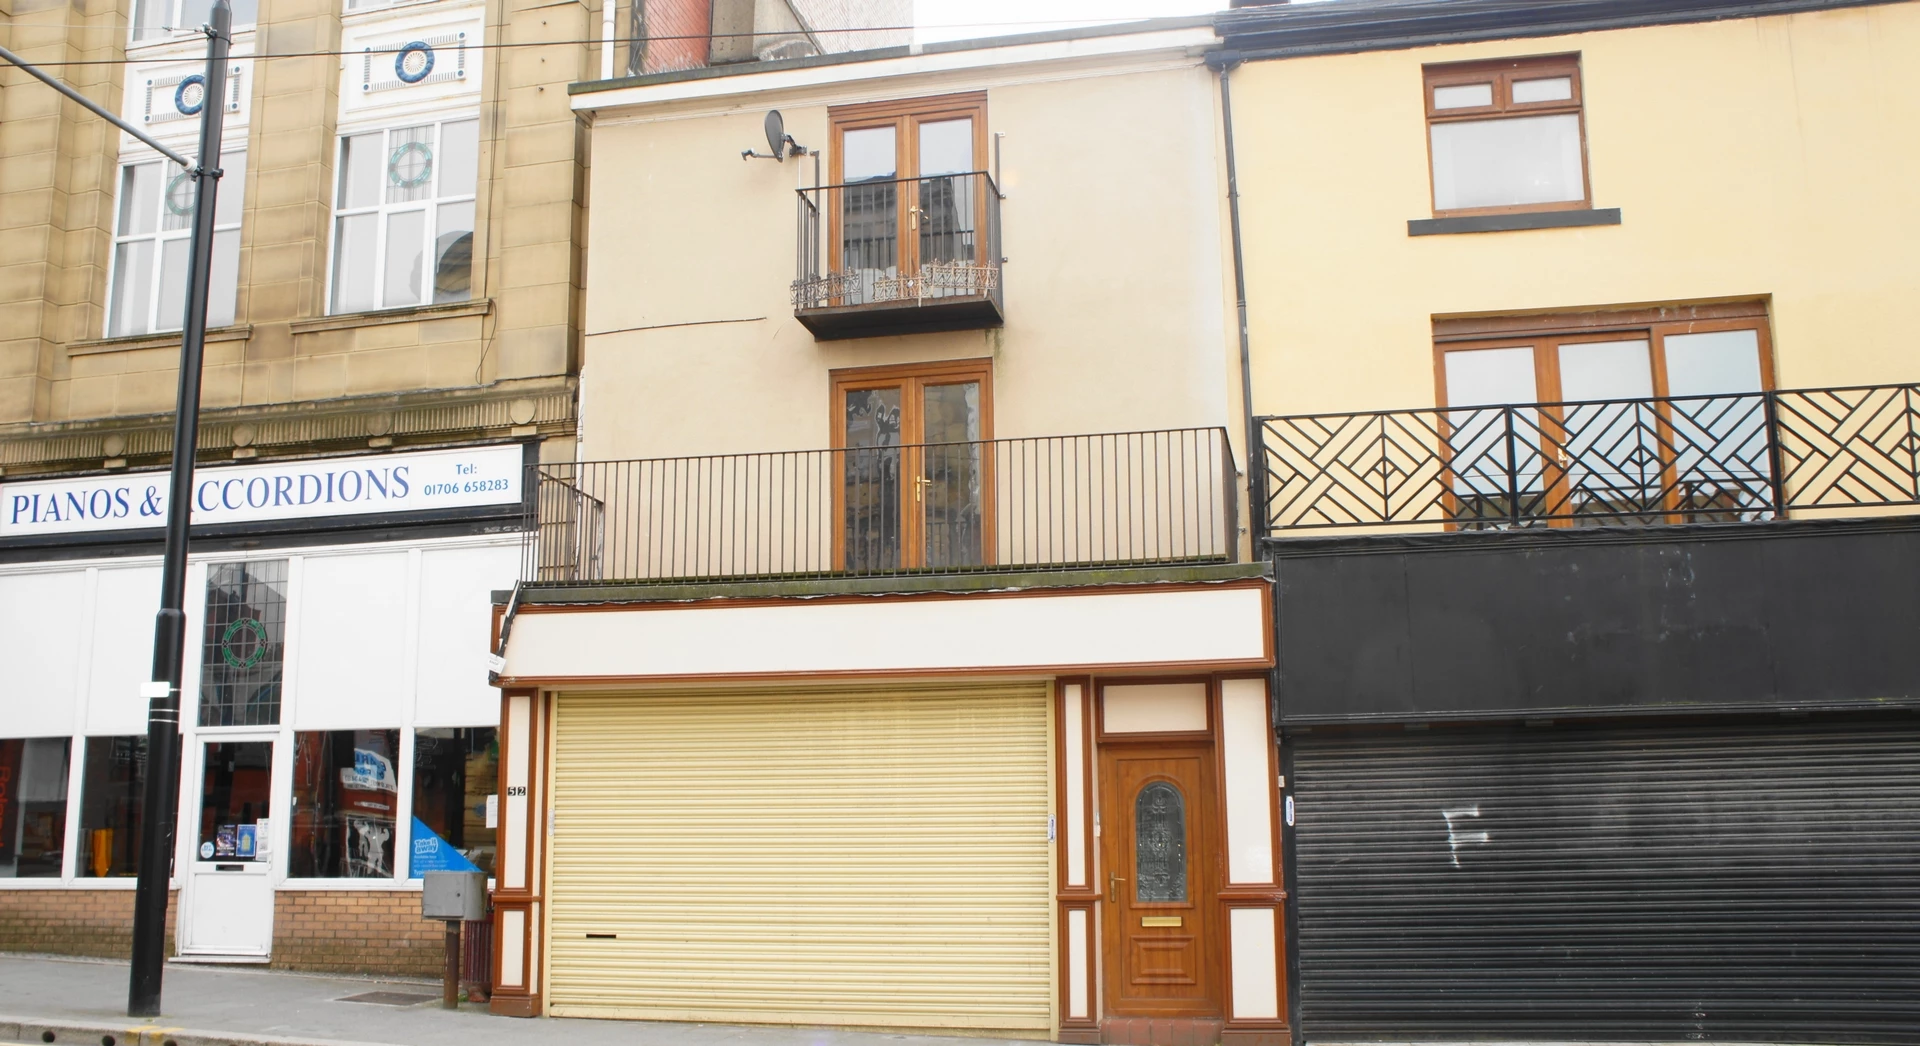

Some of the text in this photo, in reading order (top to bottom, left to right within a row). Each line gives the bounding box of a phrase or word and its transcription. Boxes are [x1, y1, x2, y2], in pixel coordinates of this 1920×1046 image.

[456, 463, 478, 475] Tel:
[10, 465, 410, 525] PIANOS & CCORDIONS
[424, 478, 509, 496] 01706 658283
[508, 786, 526, 796] 52
[1442, 806, 1489, 869] F
